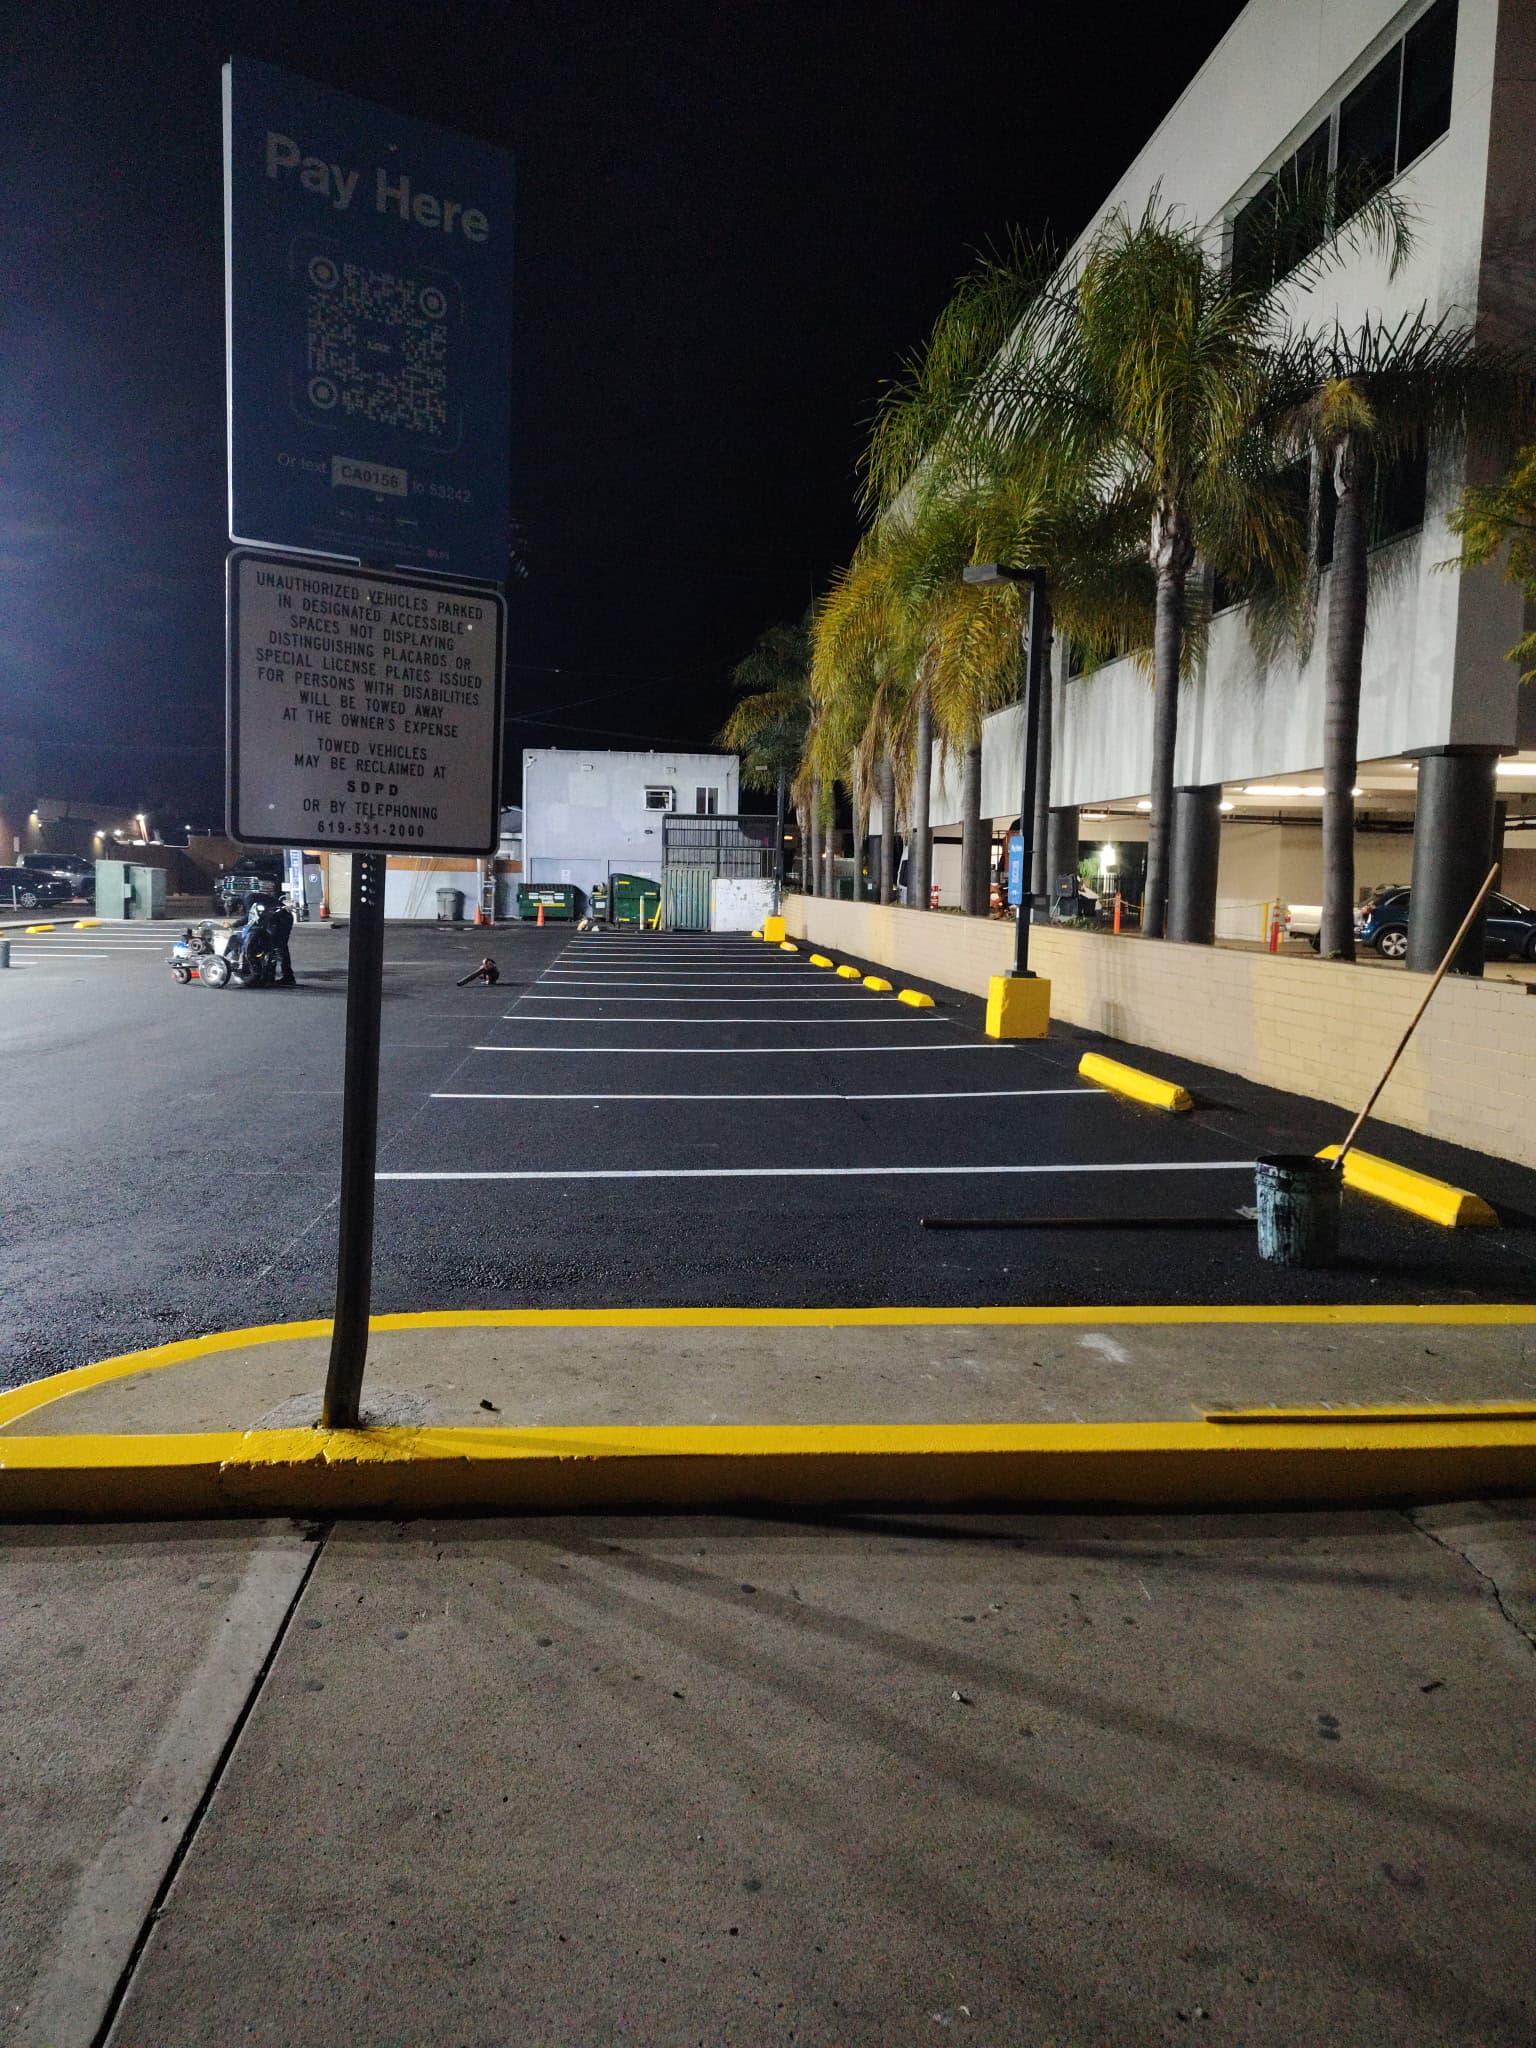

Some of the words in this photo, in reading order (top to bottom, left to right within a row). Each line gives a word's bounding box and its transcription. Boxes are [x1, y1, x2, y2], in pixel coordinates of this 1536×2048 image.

[266, 131, 360, 210] Pay
[376, 167, 489, 242] Here
[256, 571, 360, 600] UNAUTHORIZED
[369, 590, 428, 612] VEHICLES
[437, 601, 483, 620] PARKED
[278, 594, 292, 608] IN
[303, 599, 381, 622] DESIGNATED
[390, 613, 464, 635] ACCESSIBLE
[269, 631, 374, 657] DISTINGUISHING
[383, 647, 447, 667] PLACARDS
[456, 656, 471, 670] OR
[290, 615, 339, 634] SPACES
[350, 623, 373, 639] NOT
[383, 628, 454, 651] DISPLAYING
[256, 648, 312, 668] SPECIAL
[323, 656, 375, 676] LICENSE
[385, 665, 431, 683] PLATES
[439, 673, 481, 689] ISSUED
[258, 667, 284, 684] FOR
[295, 672, 355, 691] PERSONS
[364, 680, 394, 697] WITH
[404, 685, 479, 707] DISABILITIES
[300, 690, 331, 706] WILL
[341, 695, 355, 709] BE
[366, 698, 406, 715] TOWED
[414, 704, 444, 719] AWAY
[283, 708, 298, 721] AT
[308, 709, 331, 725] THE
[341, 714, 395, 731] OWNER'S
[404, 721, 458, 738] EXPENSE
[294, 754, 319, 768] MAY
[331, 757, 346, 770] BE
[356, 759, 424, 777] RECLAIMED
[433, 766, 447, 779] AT
[318, 738, 360, 754] TOWED
[369, 743, 427, 760] VEHICLES
[303, 799, 320, 811] OR
[330, 801, 348, 814] BY
[356, 802, 438, 820] TELEPHONING
[318, 821, 424, 836] 619-531-2000
